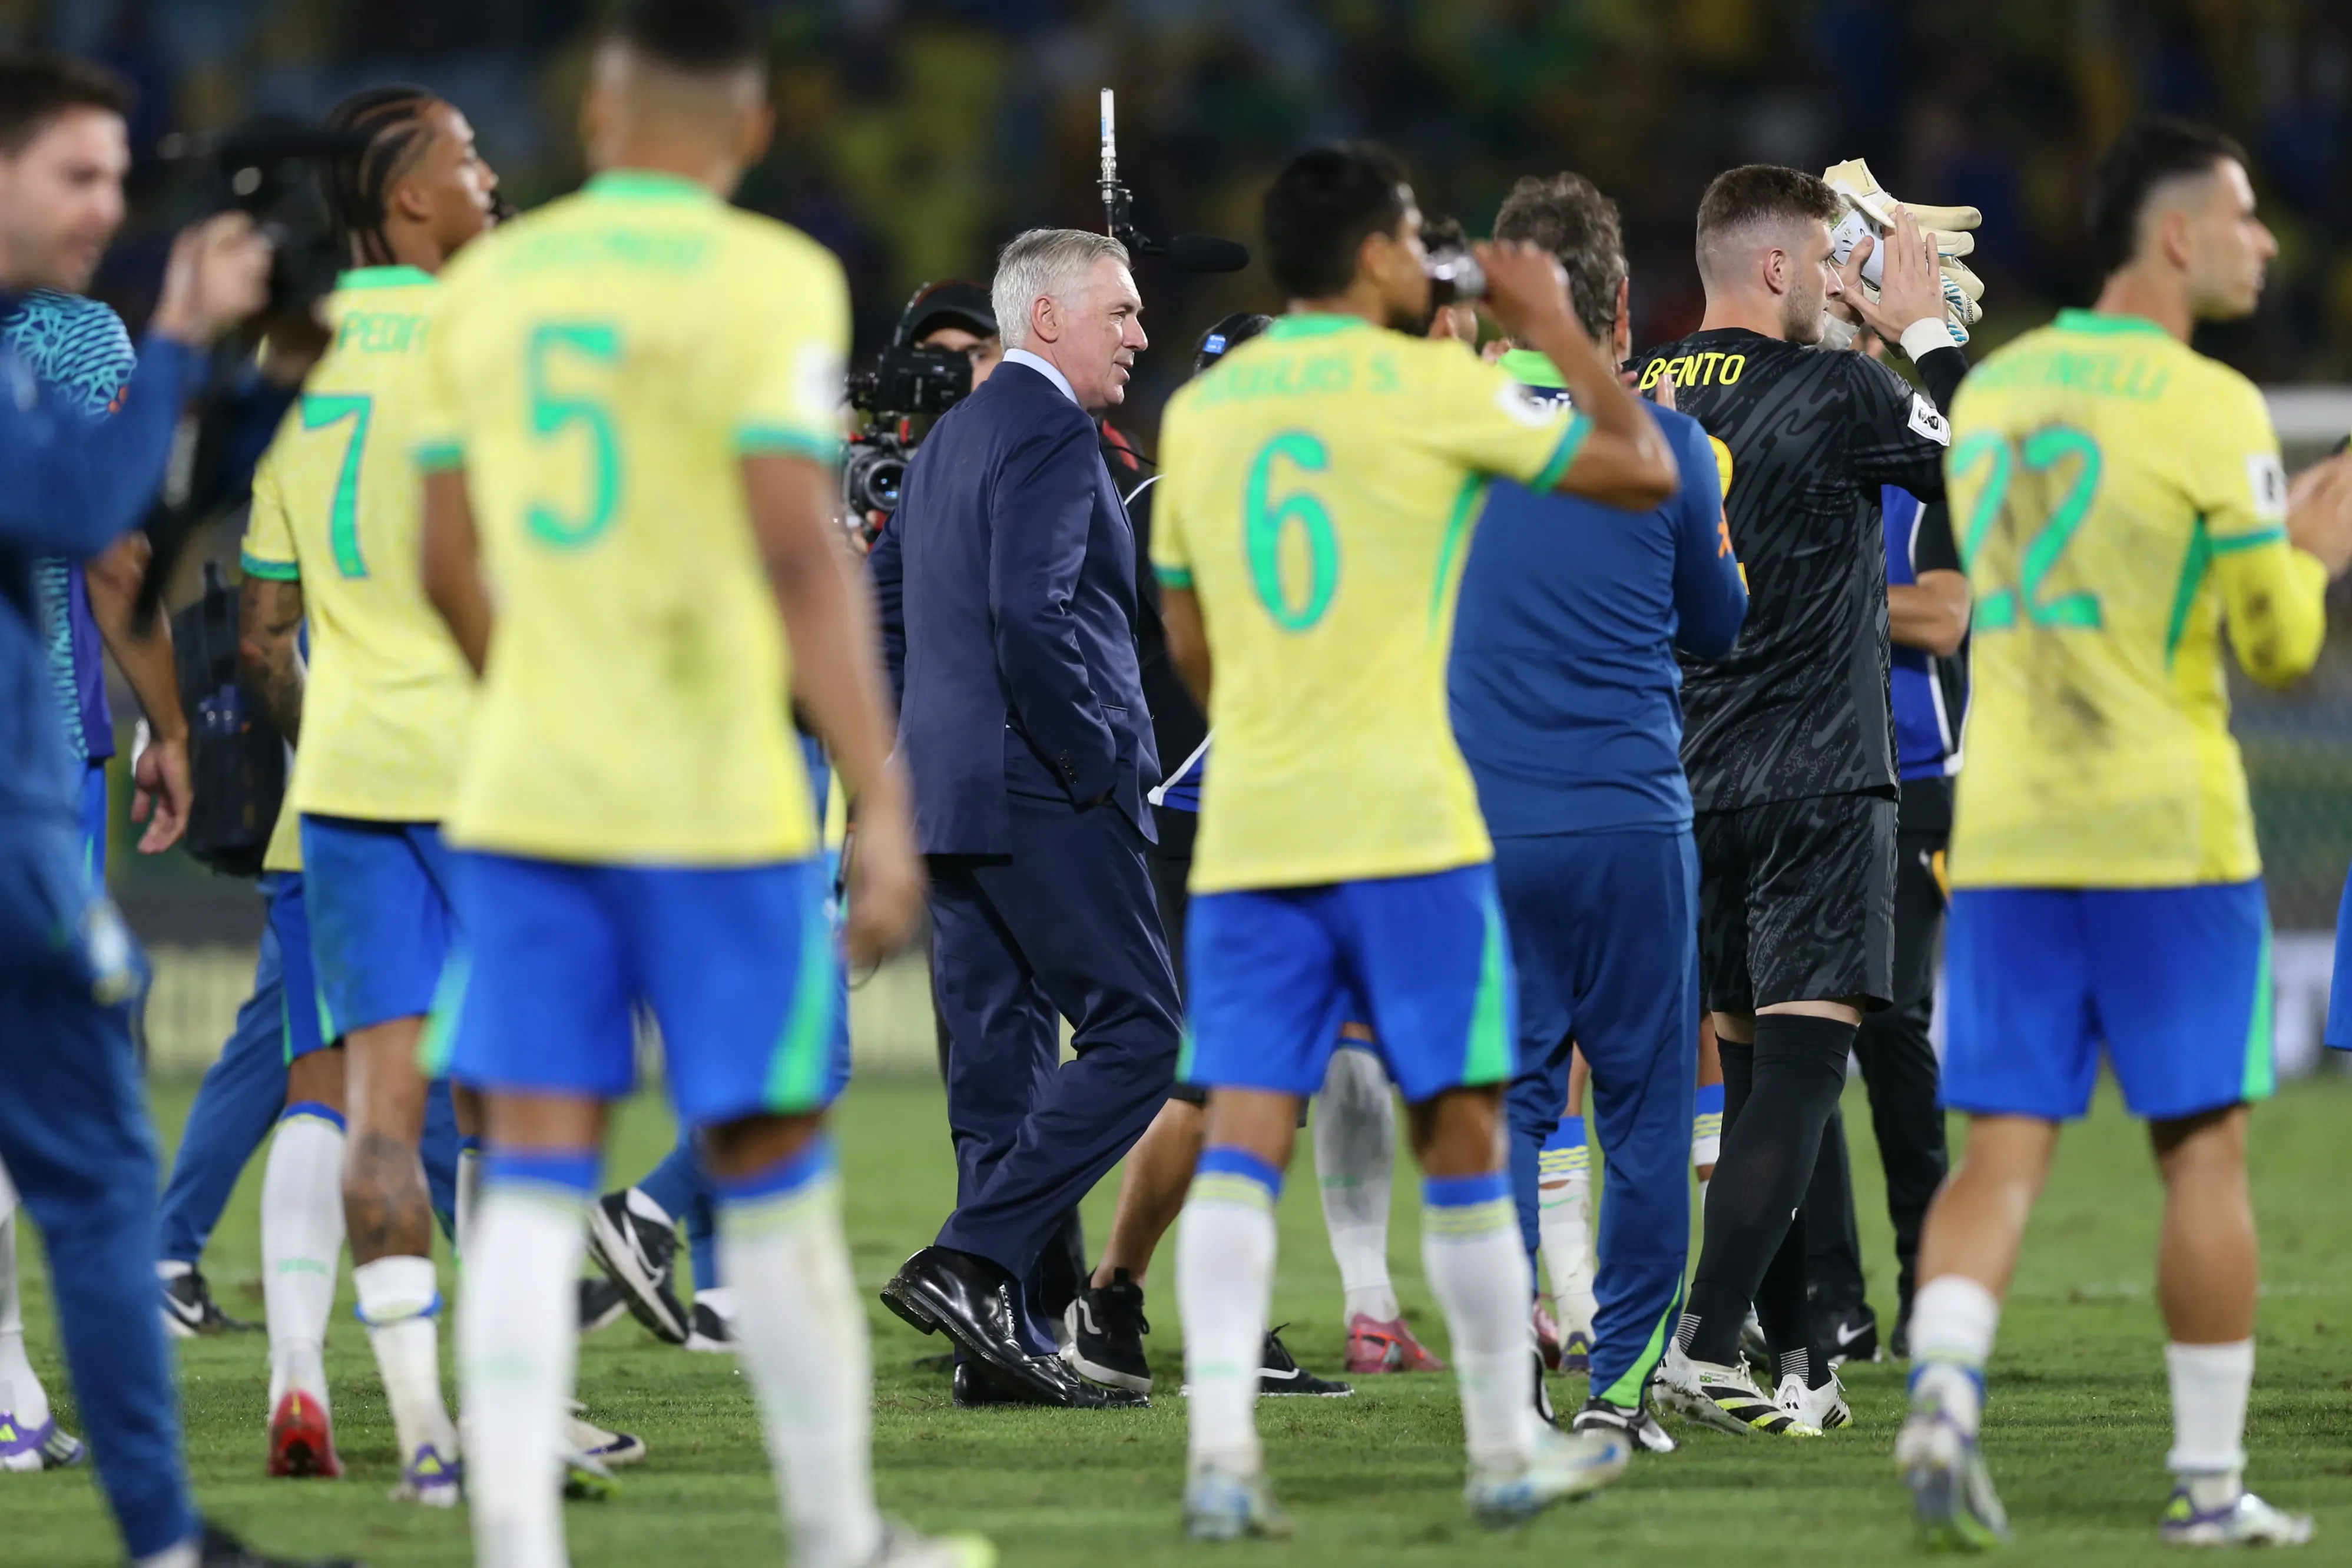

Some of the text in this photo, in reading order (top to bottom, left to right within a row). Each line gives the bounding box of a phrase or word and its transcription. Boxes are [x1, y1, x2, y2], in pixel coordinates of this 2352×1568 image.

[526, 325, 624, 549] 5
[1639, 352, 1745, 390] BENTO
[300, 394, 372, 579] 7
[1244, 431, 1340, 631] 6
[1952, 426, 2104, 633] 22
